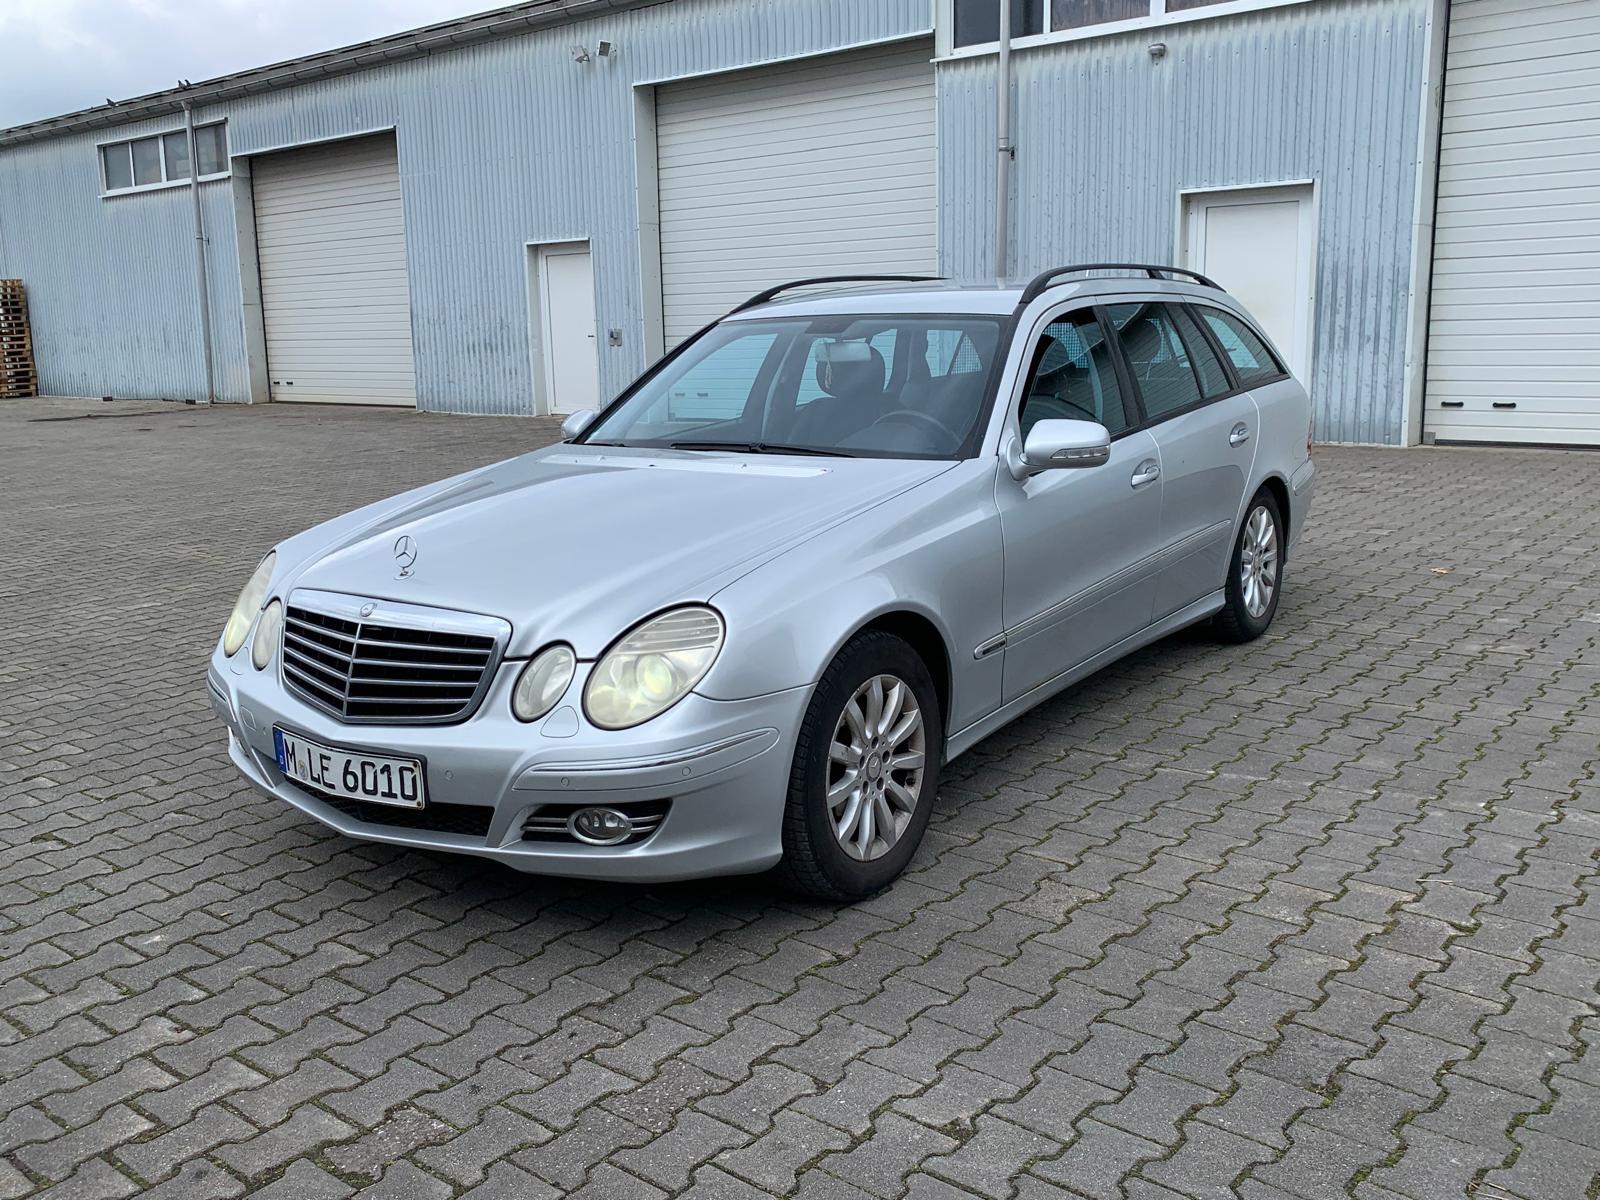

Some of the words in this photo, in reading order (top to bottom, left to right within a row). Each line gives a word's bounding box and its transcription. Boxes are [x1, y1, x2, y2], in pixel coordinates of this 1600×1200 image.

[284, 738, 297, 774] M
[307, 748, 336, 789] LE
[342, 759, 418, 800] 6010
